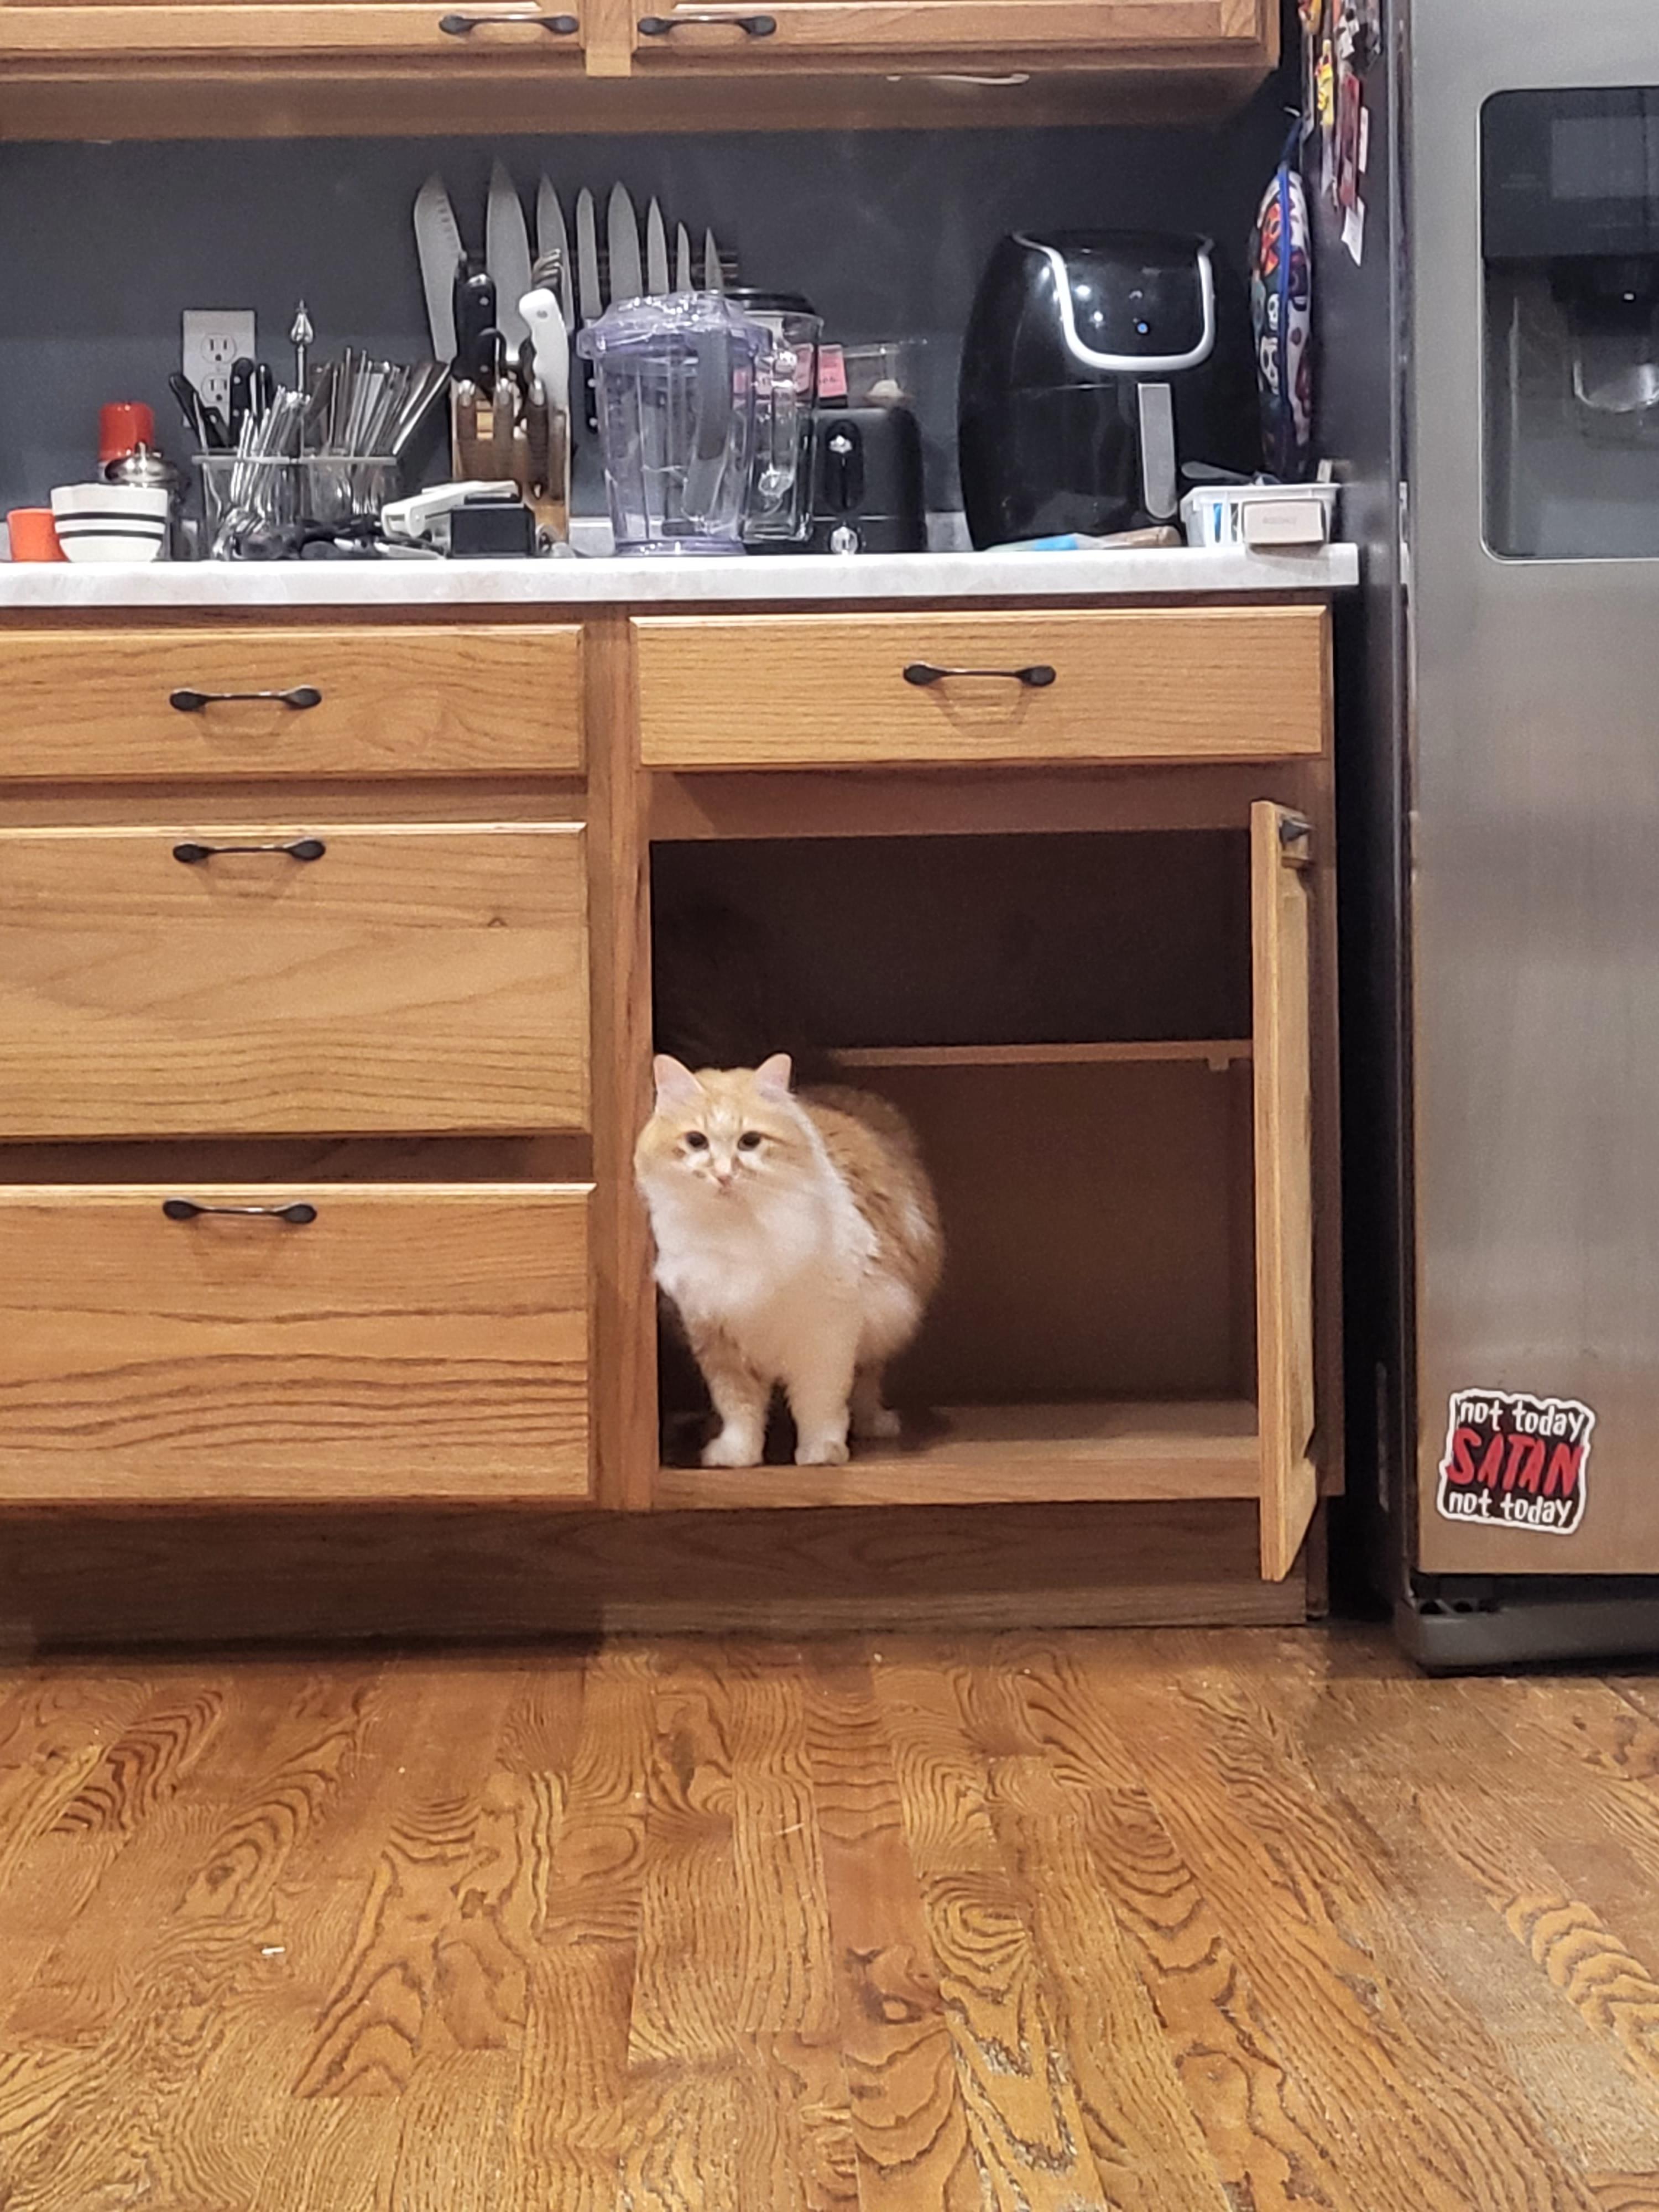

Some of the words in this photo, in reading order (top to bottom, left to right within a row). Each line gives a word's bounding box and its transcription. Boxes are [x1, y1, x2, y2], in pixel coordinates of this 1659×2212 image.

[1460, 1400, 1503, 1431] not
[1512, 1400, 1585, 1442] today
[1446, 1427, 1584, 1496] SATAN
[1449, 1488, 1492, 1517] not
[1500, 1492, 1573, 1527] today
